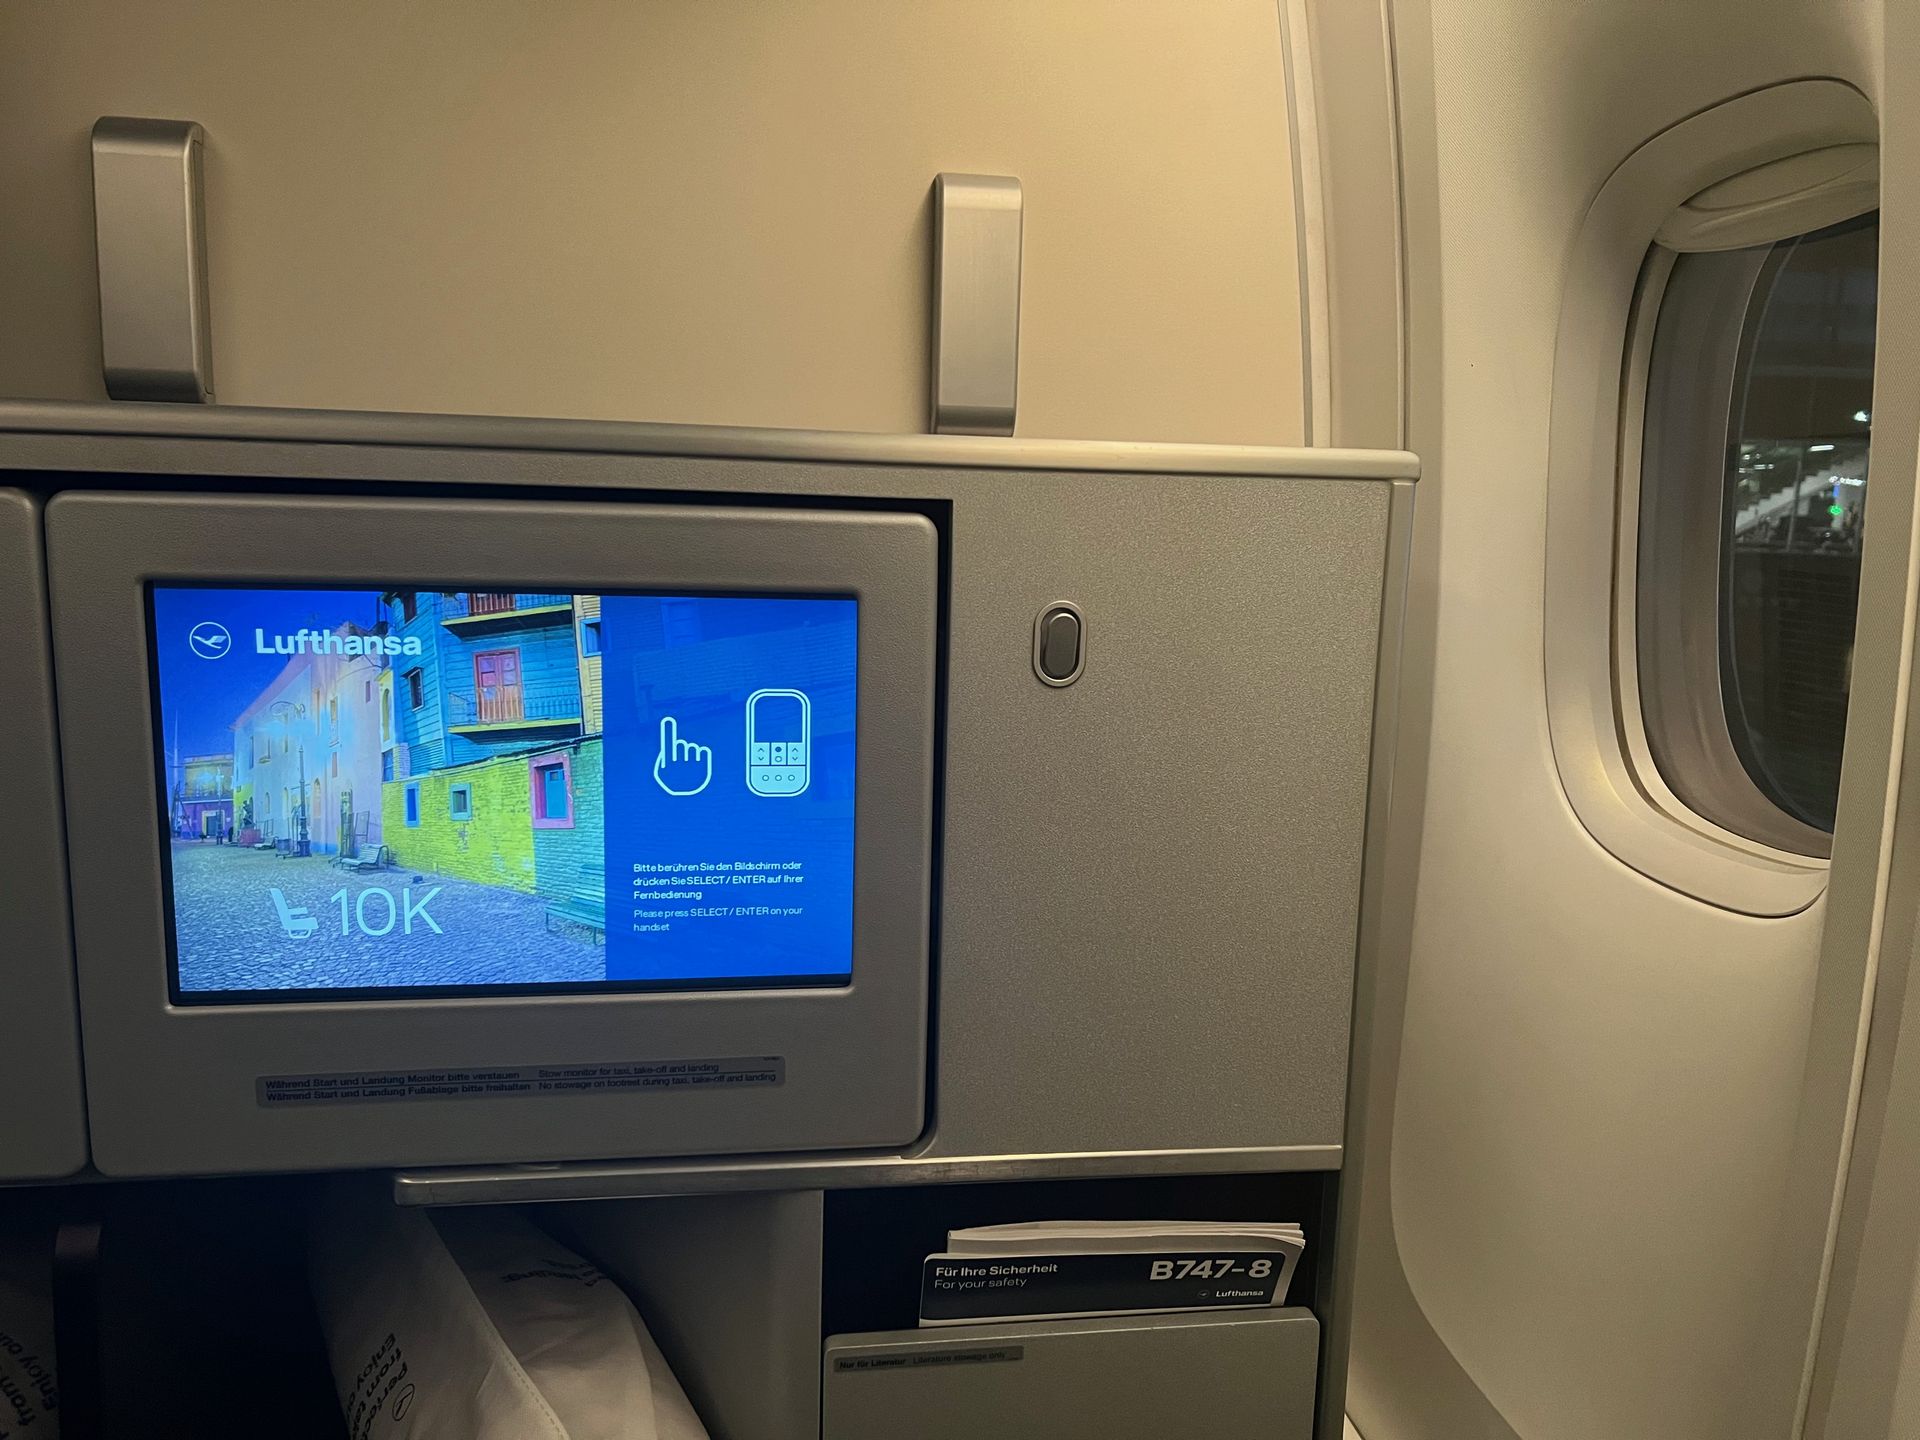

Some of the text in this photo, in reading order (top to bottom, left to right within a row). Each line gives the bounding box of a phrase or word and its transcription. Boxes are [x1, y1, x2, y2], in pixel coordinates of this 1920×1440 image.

[255, 628, 422, 656] Lufthansa
[633, 861, 803, 873] Bitte berühren Sie den Bildschirm oder
[633, 877, 670, 887] drücken
[671, 876, 687, 886] Sie
[686, 875, 725, 885] SELECT
[732, 875, 766, 884] ENTER
[766, 874, 782, 884] auf
[783, 874, 804, 883] Ihrer
[633, 890, 703, 901] Fernbedienung
[330, 887, 444, 937] 10K
[633, 909, 664, 919] Please
[664, 910, 689, 920] press
[690, 907, 728, 917] SELECT
[735, 906, 769, 916] ENTER
[782, 907, 803, 917] your
[633, 923, 670, 932] handset
[599, 1067, 611, 1076] for
[669, 1065, 687, 1073] and
[687, 1063, 720, 1073] landing
[265, 1079, 310, 1089] Während
[312, 1078, 337, 1087] Start
[361, 1075, 405, 1086] Landung
[407, 1074, 446, 1083] Monitor
[447, 1072, 470, 1082] bitte
[538, 1081, 553, 1090] No
[727, 1073, 744, 1082] and
[745, 1071, 777, 1082] landing
[313, 1090, 338, 1099] Start
[340, 1089, 360, 1097] und
[362, 1086, 406, 1098] Landung
[461, 1083, 484, 1093] bitte
[935, 1263, 1059, 1277] Für Ihre Sicherheit
[1148, 1257, 1273, 1281] B747-8
[934, 1276, 1029, 1292] For your safety
[1214, 1288, 1265, 1298] Lufthansa
[356, 1333, 396, 1391] Enjoy
[839, 1361, 856, 1370] Nur
[366, 1347, 402, 1398] from
